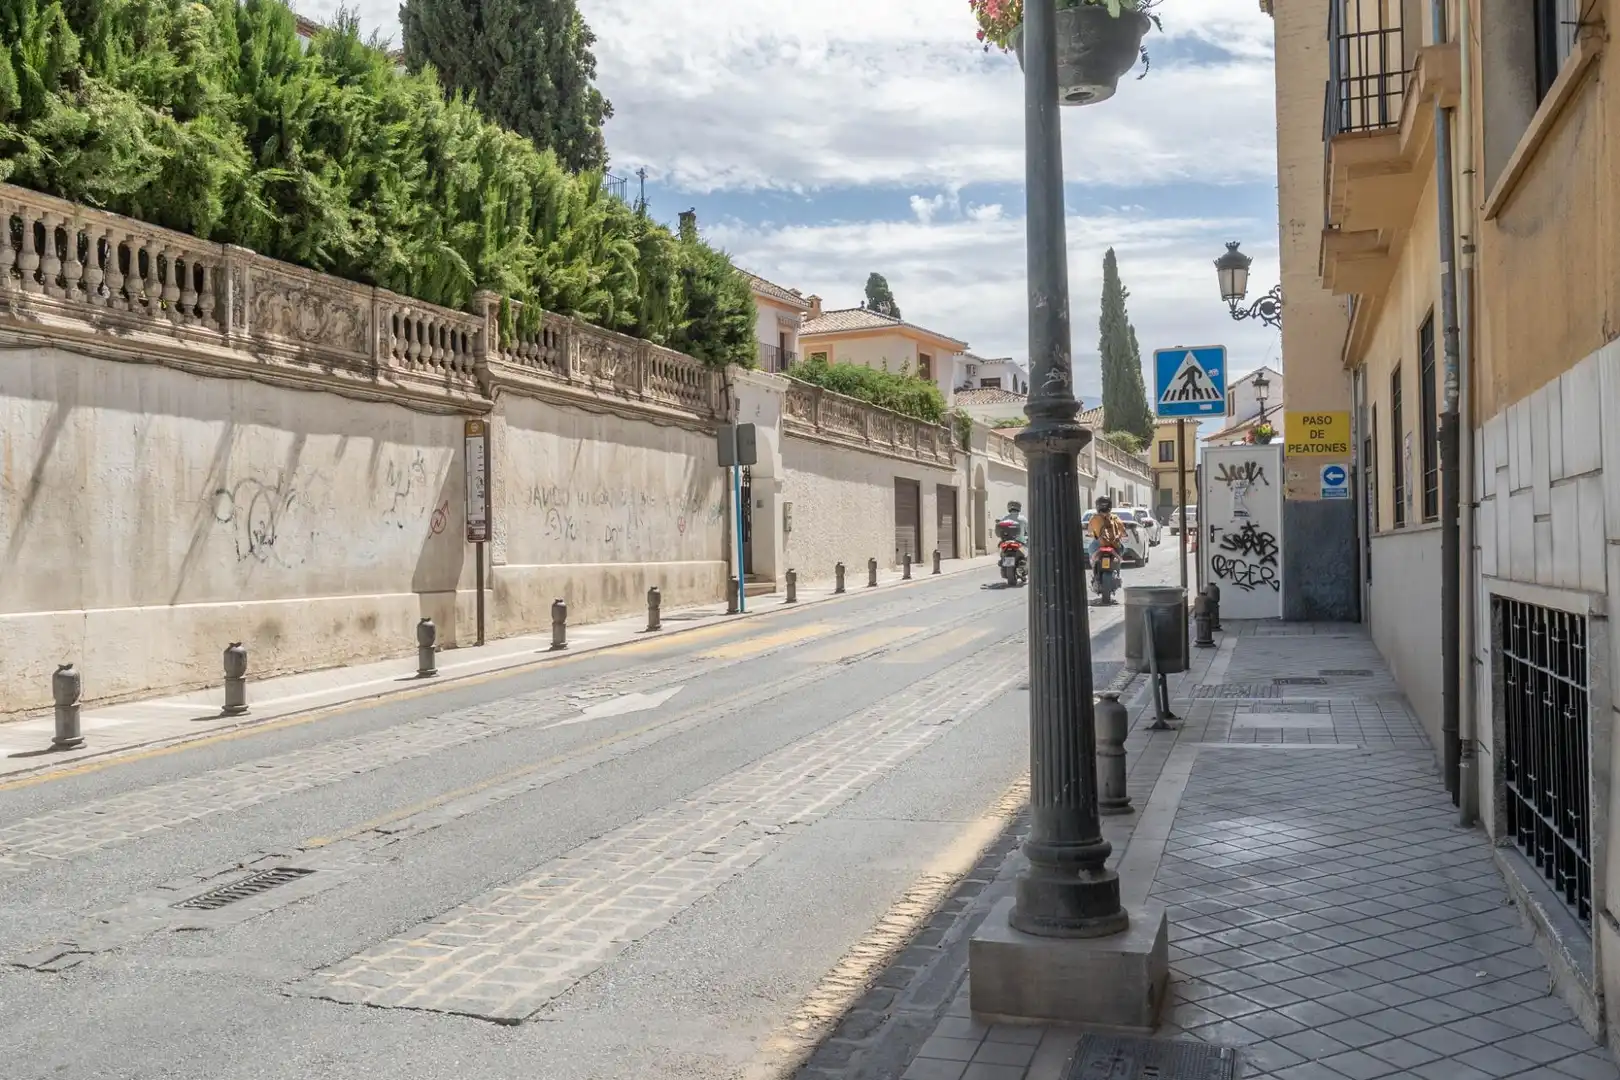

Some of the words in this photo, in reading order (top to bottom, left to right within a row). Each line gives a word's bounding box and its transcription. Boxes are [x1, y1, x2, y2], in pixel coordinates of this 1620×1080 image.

[1302, 415, 1333, 425] PASO
[1309, 429, 1325, 439] DE
[1288, 442, 1347, 453] PEATONES
